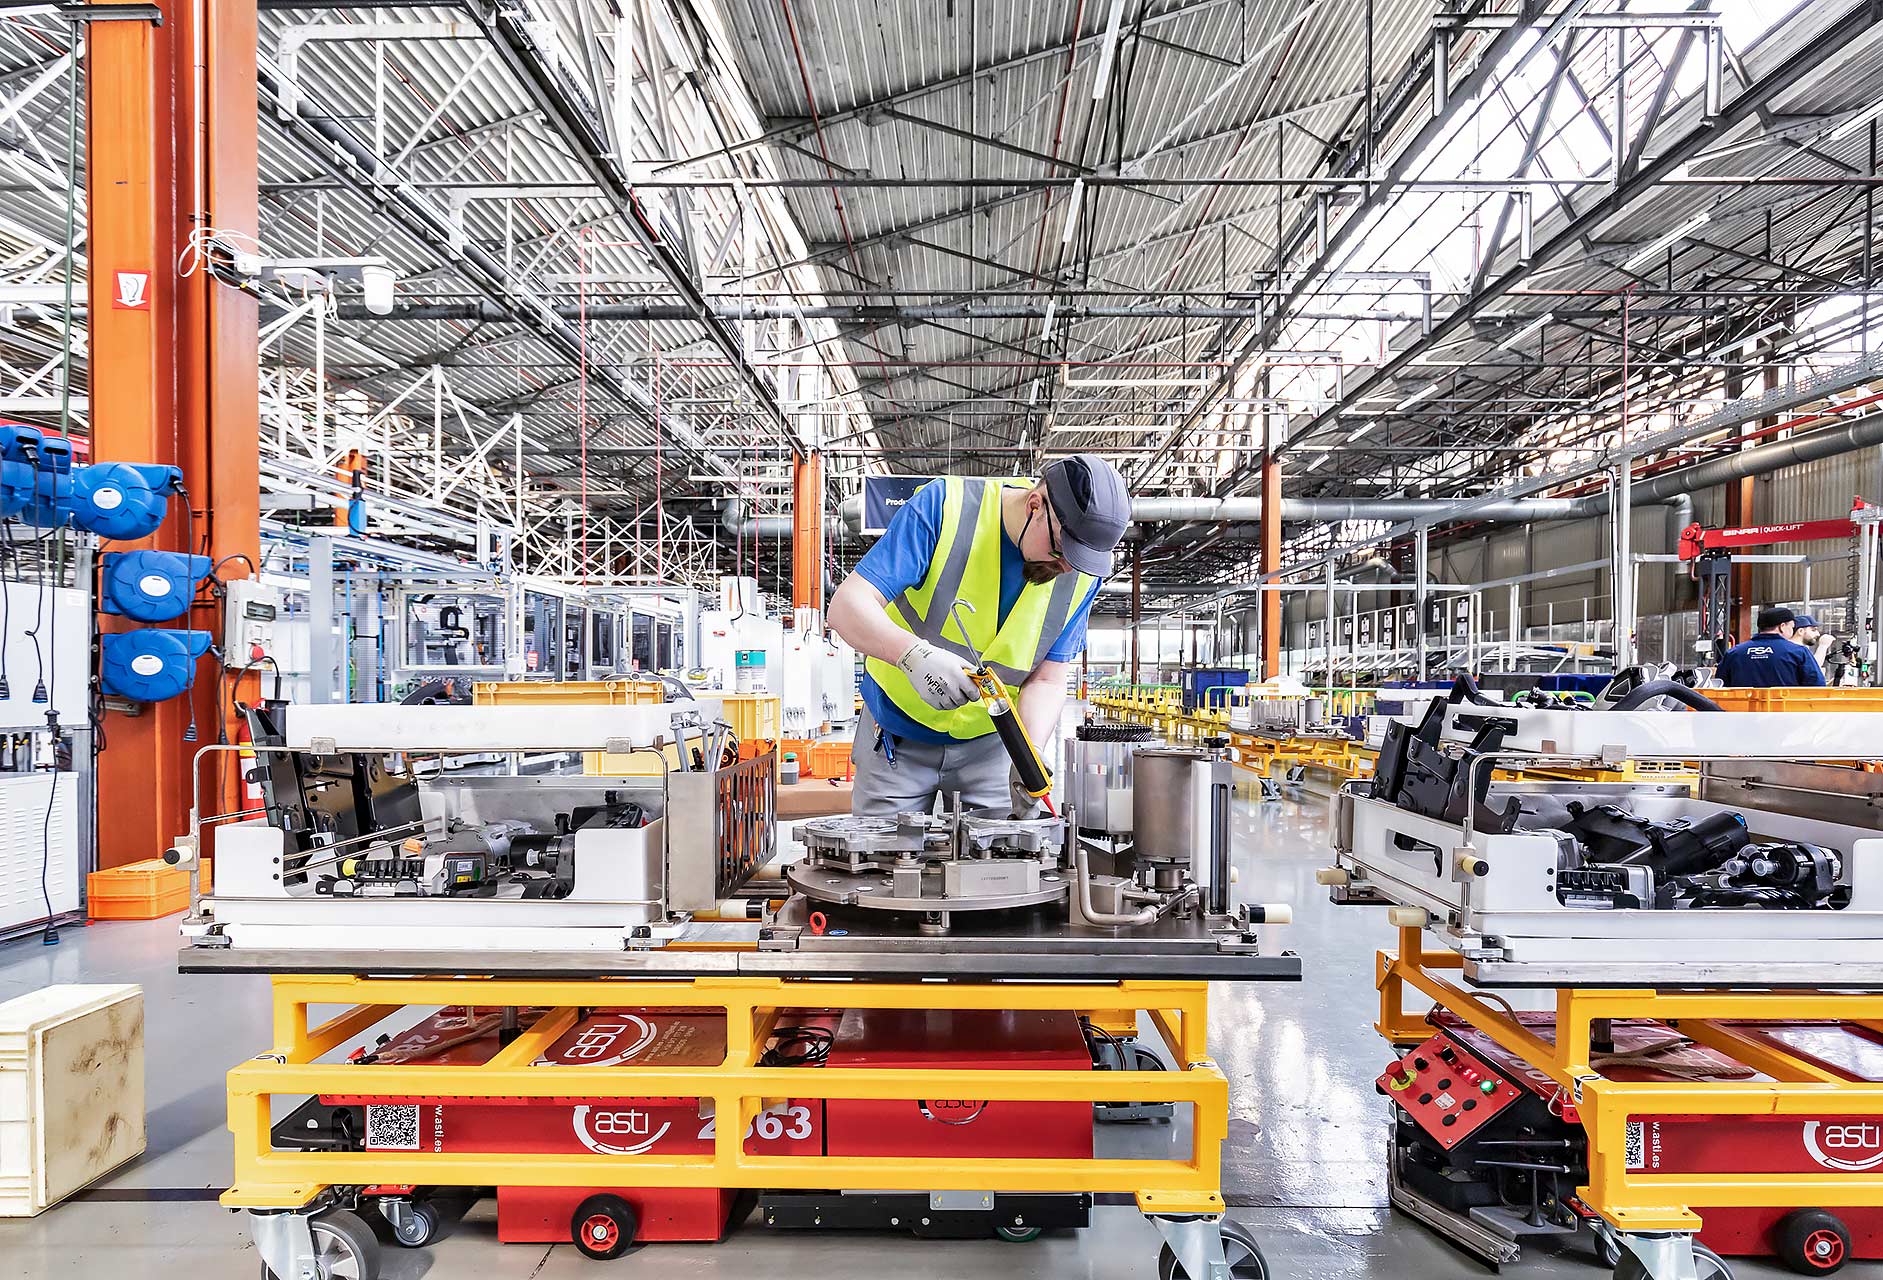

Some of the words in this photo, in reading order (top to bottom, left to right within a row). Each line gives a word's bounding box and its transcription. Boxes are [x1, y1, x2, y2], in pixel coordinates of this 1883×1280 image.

[1747, 646, 1774, 655] PSA
[924, 673, 946, 697] HyFlex
[564, 1024, 628, 1059] asti
[434, 1104, 444, 1153] w.asti.es
[595, 1108, 648, 1134] asti
[697, 1106, 812, 1139] 263
[1825, 1122, 1880, 1148] asti
